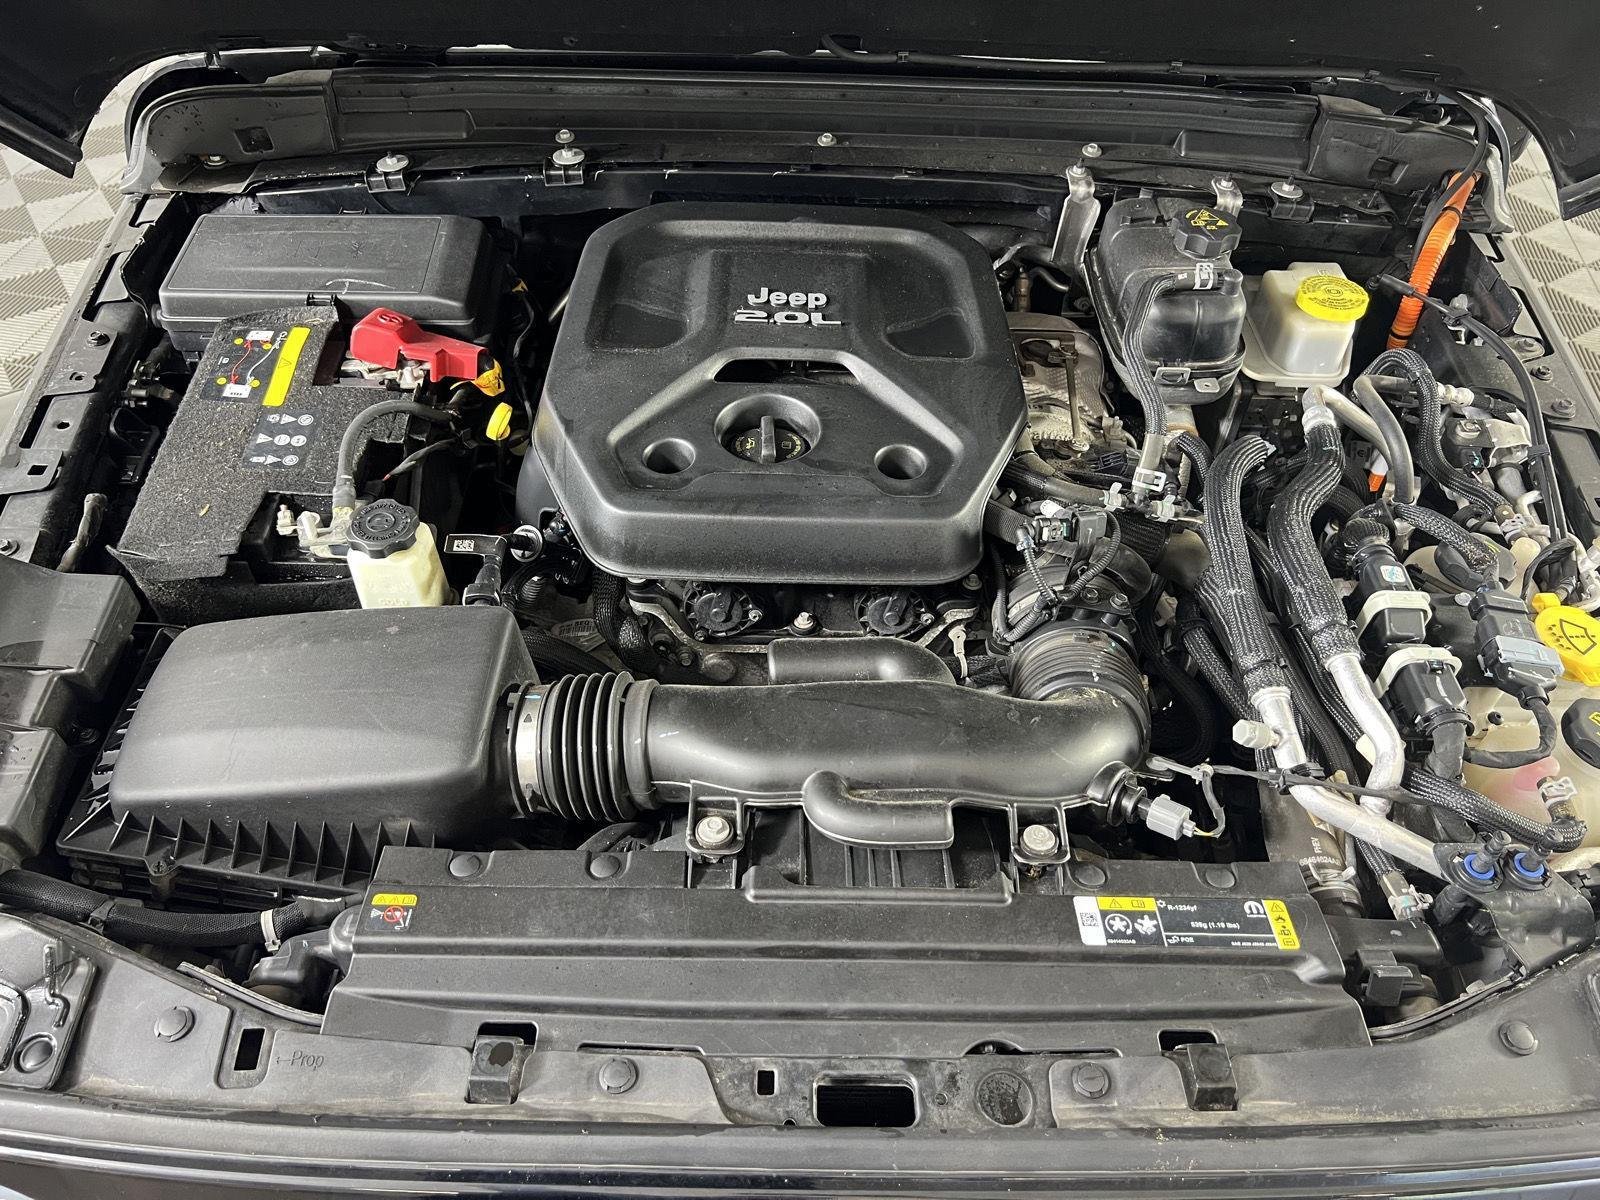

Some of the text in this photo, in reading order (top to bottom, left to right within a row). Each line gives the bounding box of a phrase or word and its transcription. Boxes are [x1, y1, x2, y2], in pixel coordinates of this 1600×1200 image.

[747, 287, 827, 309] Jeep
[735, 309, 842, 325] 2.0L
[1167, 904, 1198, 912] R-1234yf
[291, 1050, 325, 1071] Prop
